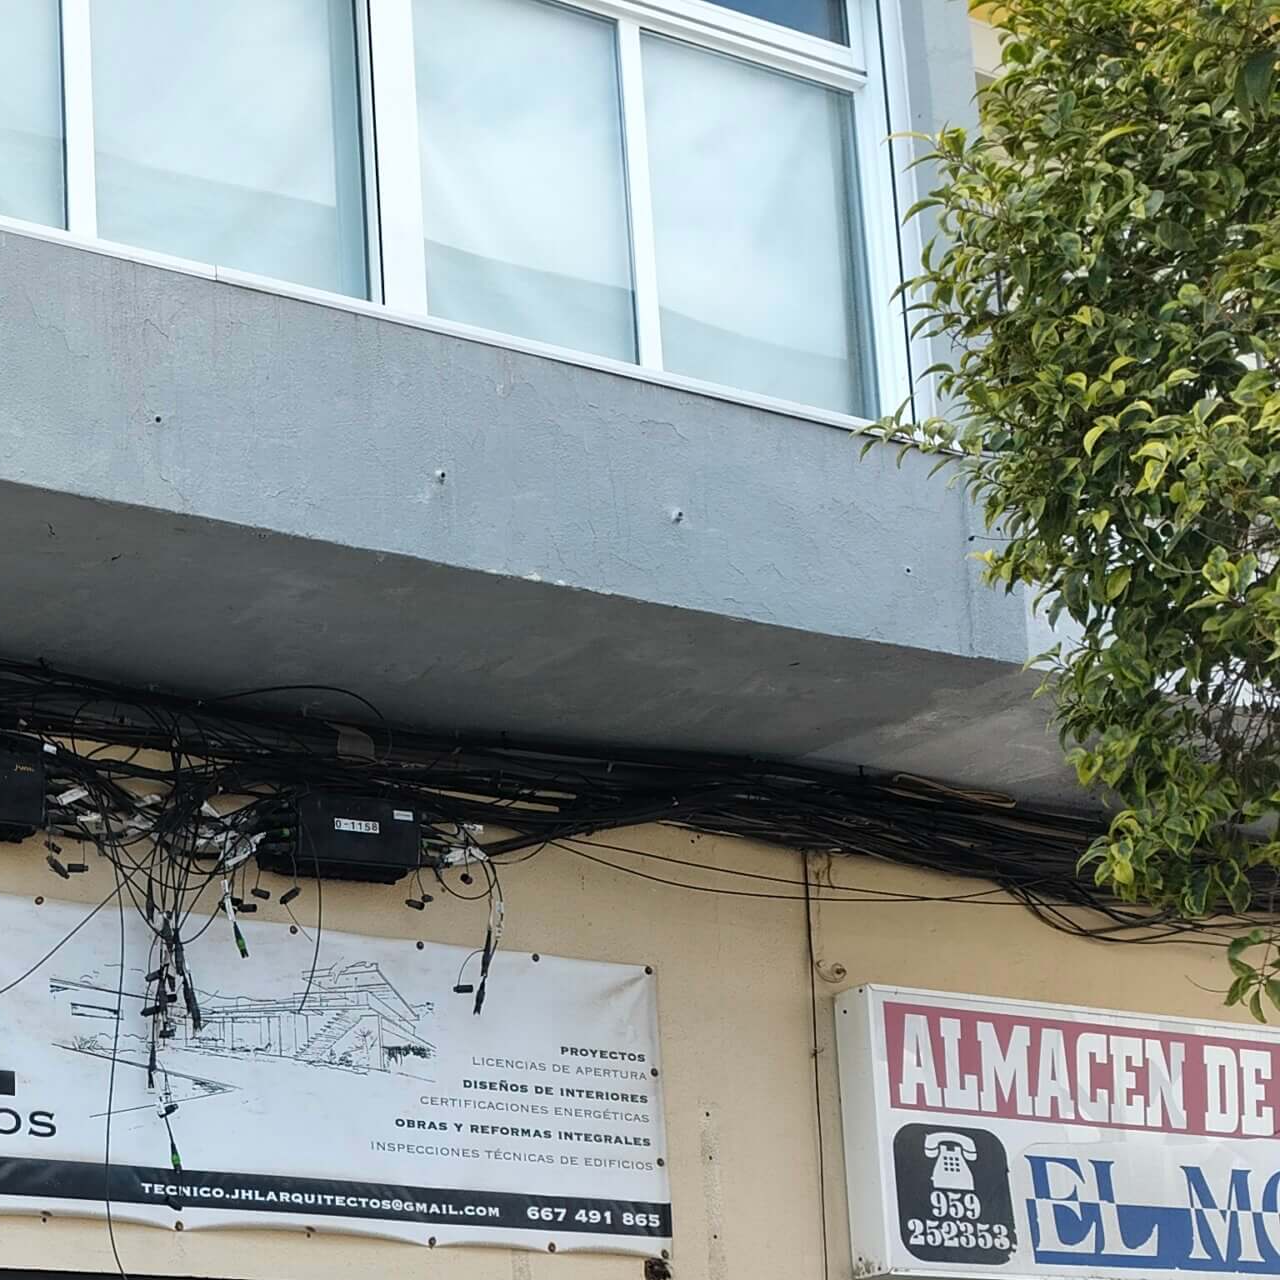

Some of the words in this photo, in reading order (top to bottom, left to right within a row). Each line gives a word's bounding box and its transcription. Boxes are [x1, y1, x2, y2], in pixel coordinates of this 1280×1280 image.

[472, 1056, 547, 1072] LICENCIAS
[552, 1064, 570, 1074] DE
[575, 1066, 648, 1081] APERTURA
[560, 1046, 646, 1063] PROYECTOS
[899, 1013, 1187, 1129] ALMACEN
[1203, 1044, 1276, 1137] DE
[463, 1079, 529, 1094] DISEÑOS
[534, 1086, 554, 1096] DE
[560, 1087, 649, 1104] INTERIORES
[419, 1095, 549, 1115] CERTIFICACIONES
[554, 1106, 650, 1123] ENERGÉTICAS
[395, 1118, 448, 1132] OBRAS
[453, 1123, 464, 1133] Y
[470, 1124, 553, 1140] REFORMAS
[558, 1130, 651, 1147] INTEGRALES
[370, 1141, 481, 1159] INSPECCIONES
[485, 1148, 555, 1165] TÉCNICAS
[560, 1156, 579, 1166] DE
[584, 1157, 654, 1171] EDIFICIOS
[141, 1182, 500, 1218] TECNICO.JHLARQUITECTOS@GMAIL.COM
[526, 1206, 567, 1222] 667
[574, 1209, 612, 1225] 491
[622, 1212, 661, 1227] 865
[930, 1190, 981, 1220] 959
[1024, 1154, 1159, 1257] EL
[1180, 1164, 1280, 1265] M
[907, 1218, 1011, 1250] 252353
